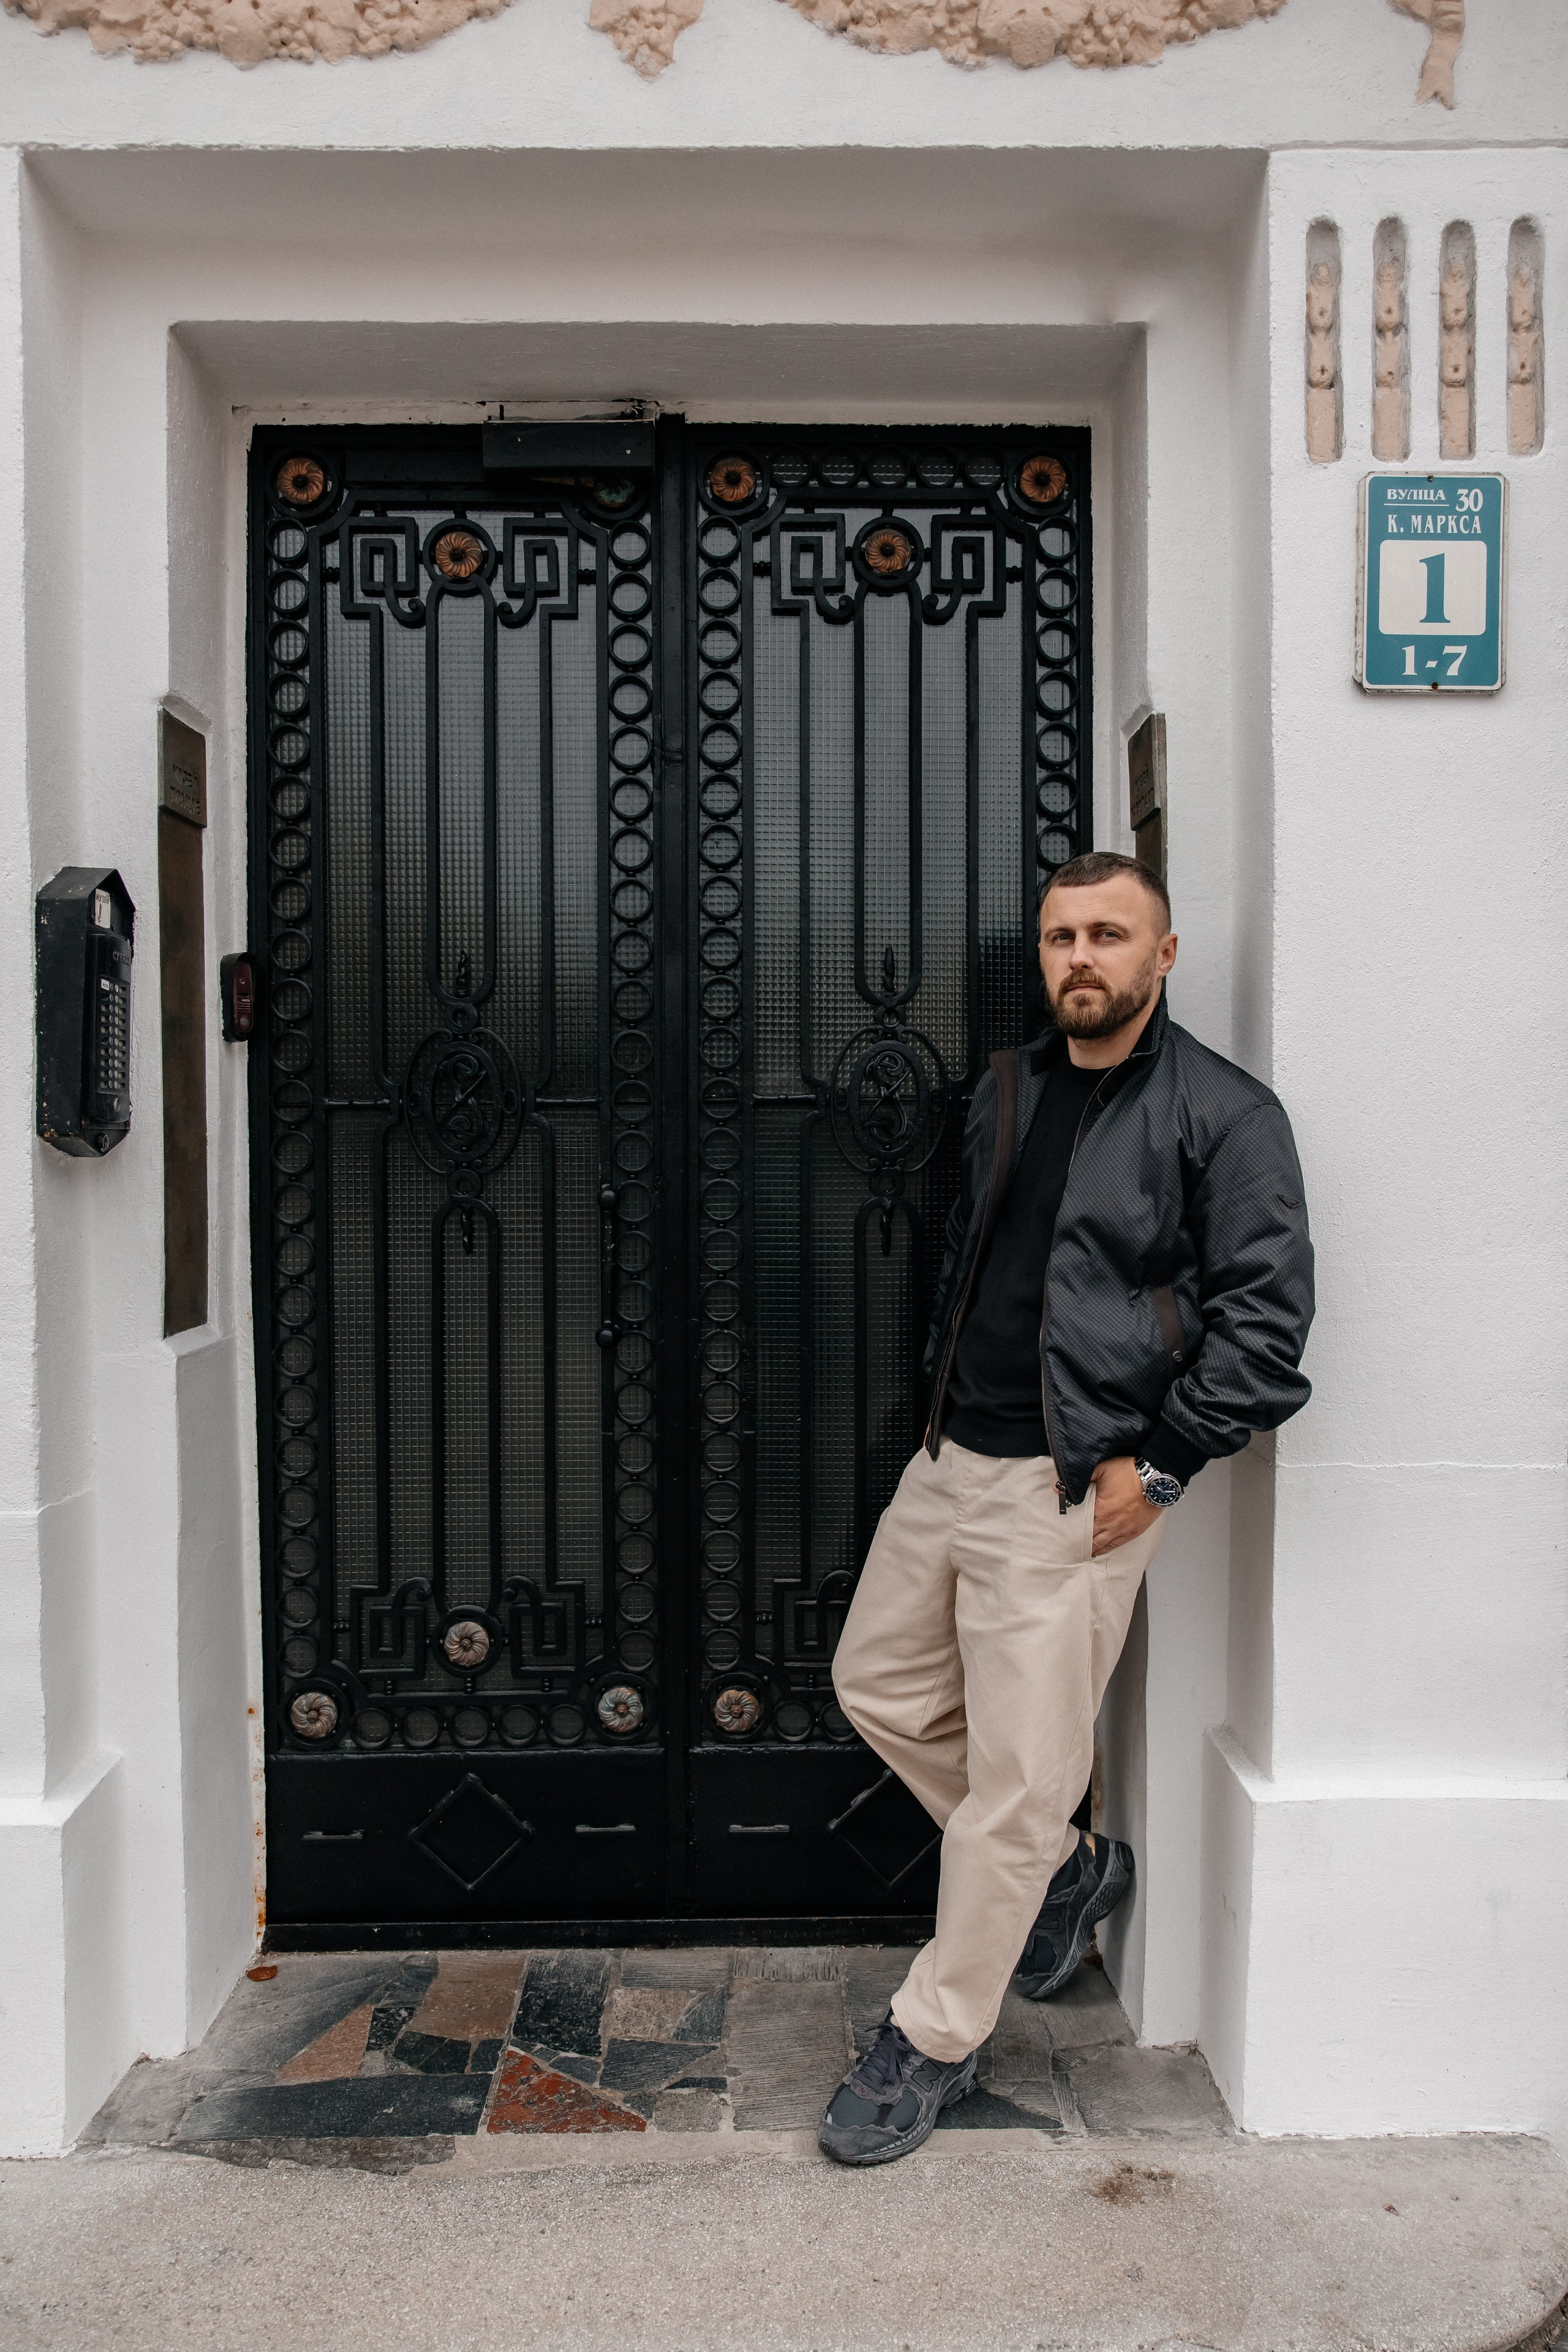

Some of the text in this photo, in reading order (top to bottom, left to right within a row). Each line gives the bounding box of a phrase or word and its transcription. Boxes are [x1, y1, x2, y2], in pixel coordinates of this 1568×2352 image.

[1387, 488, 1483, 512] ВУЛІЦА 30
[1387, 514, 1482, 533] К. МАРКСА
[1419, 552, 1450, 623] 1
[1402, 644, 1467, 676] 1-7
[96, 894, 110, 905] МУЗЕЙ
